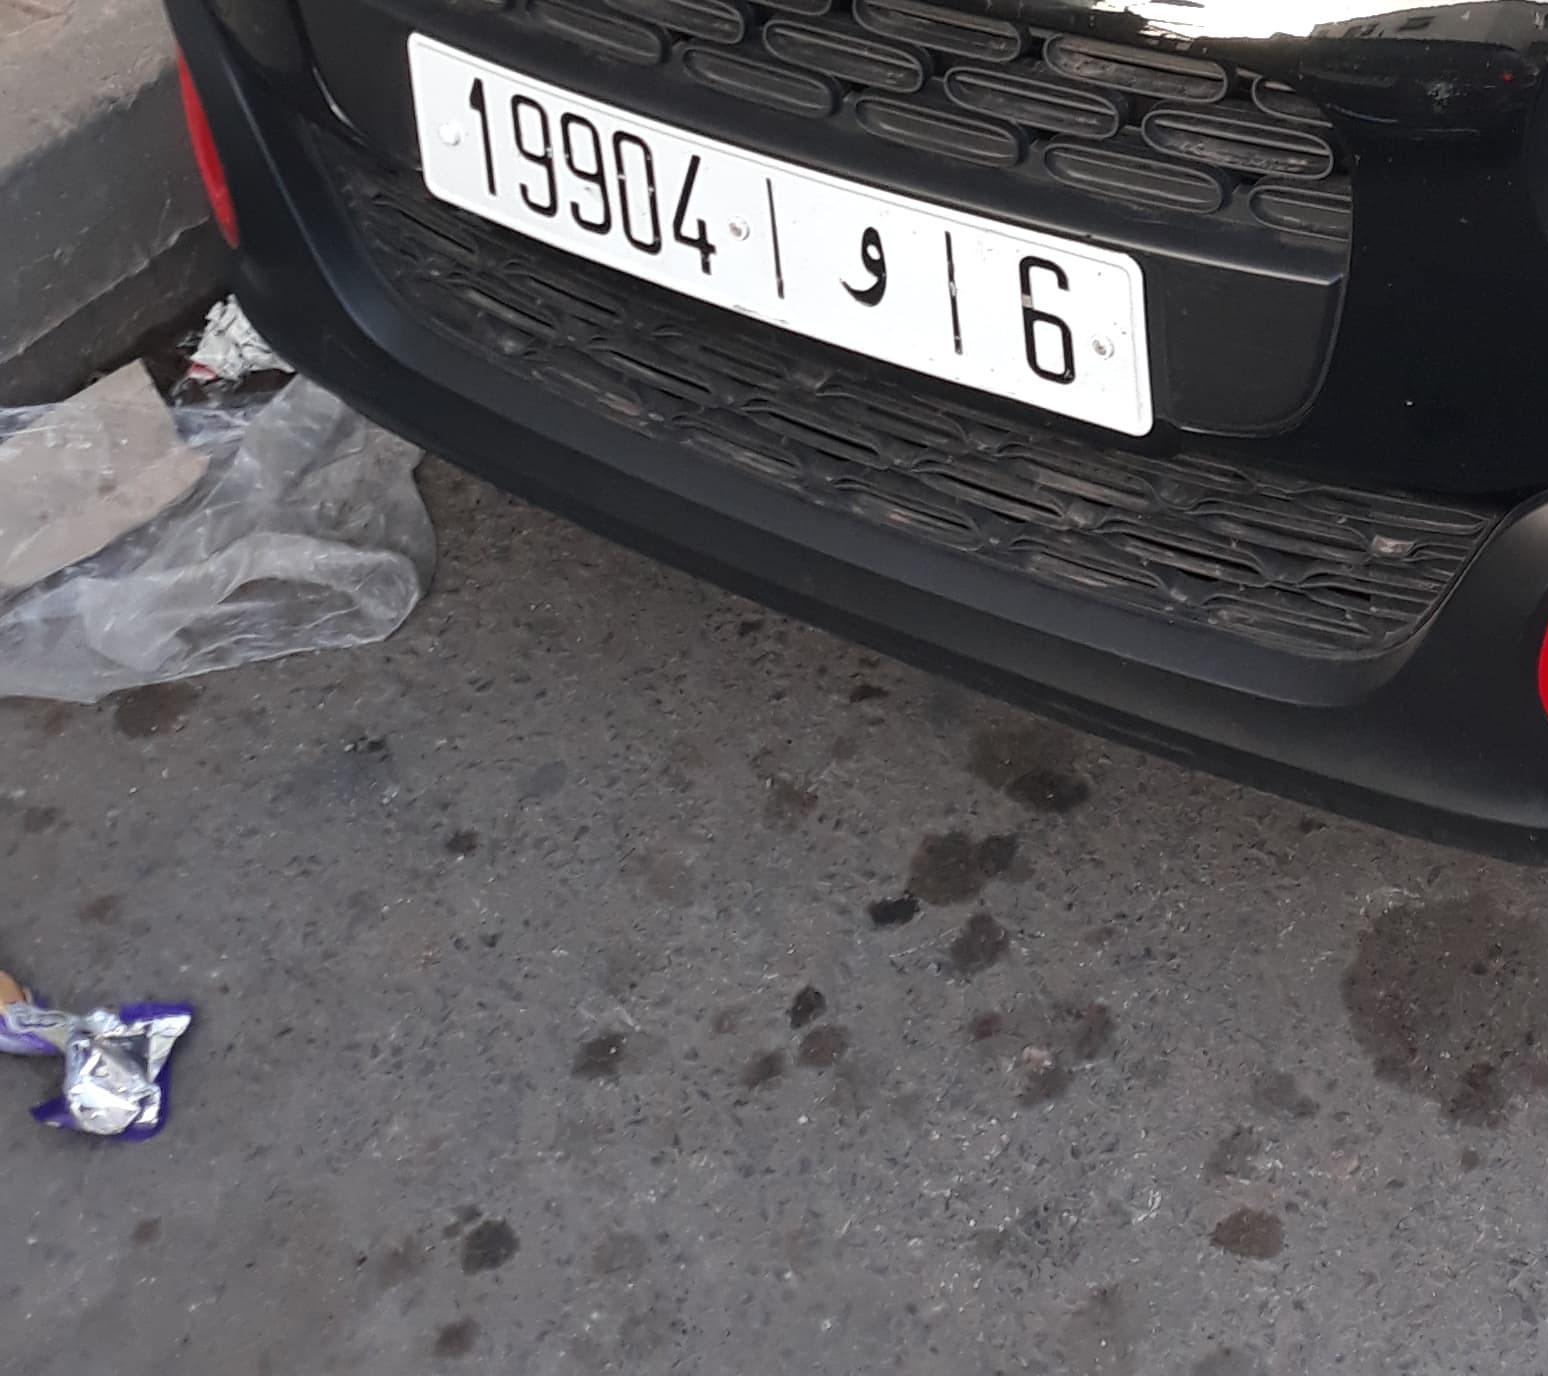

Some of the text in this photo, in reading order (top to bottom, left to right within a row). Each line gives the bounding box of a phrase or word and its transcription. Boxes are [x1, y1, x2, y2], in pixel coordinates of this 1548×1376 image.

[467, 76, 718, 277] 19904
[839, 225, 888, 307] و
[1018, 254, 1077, 385] 6
